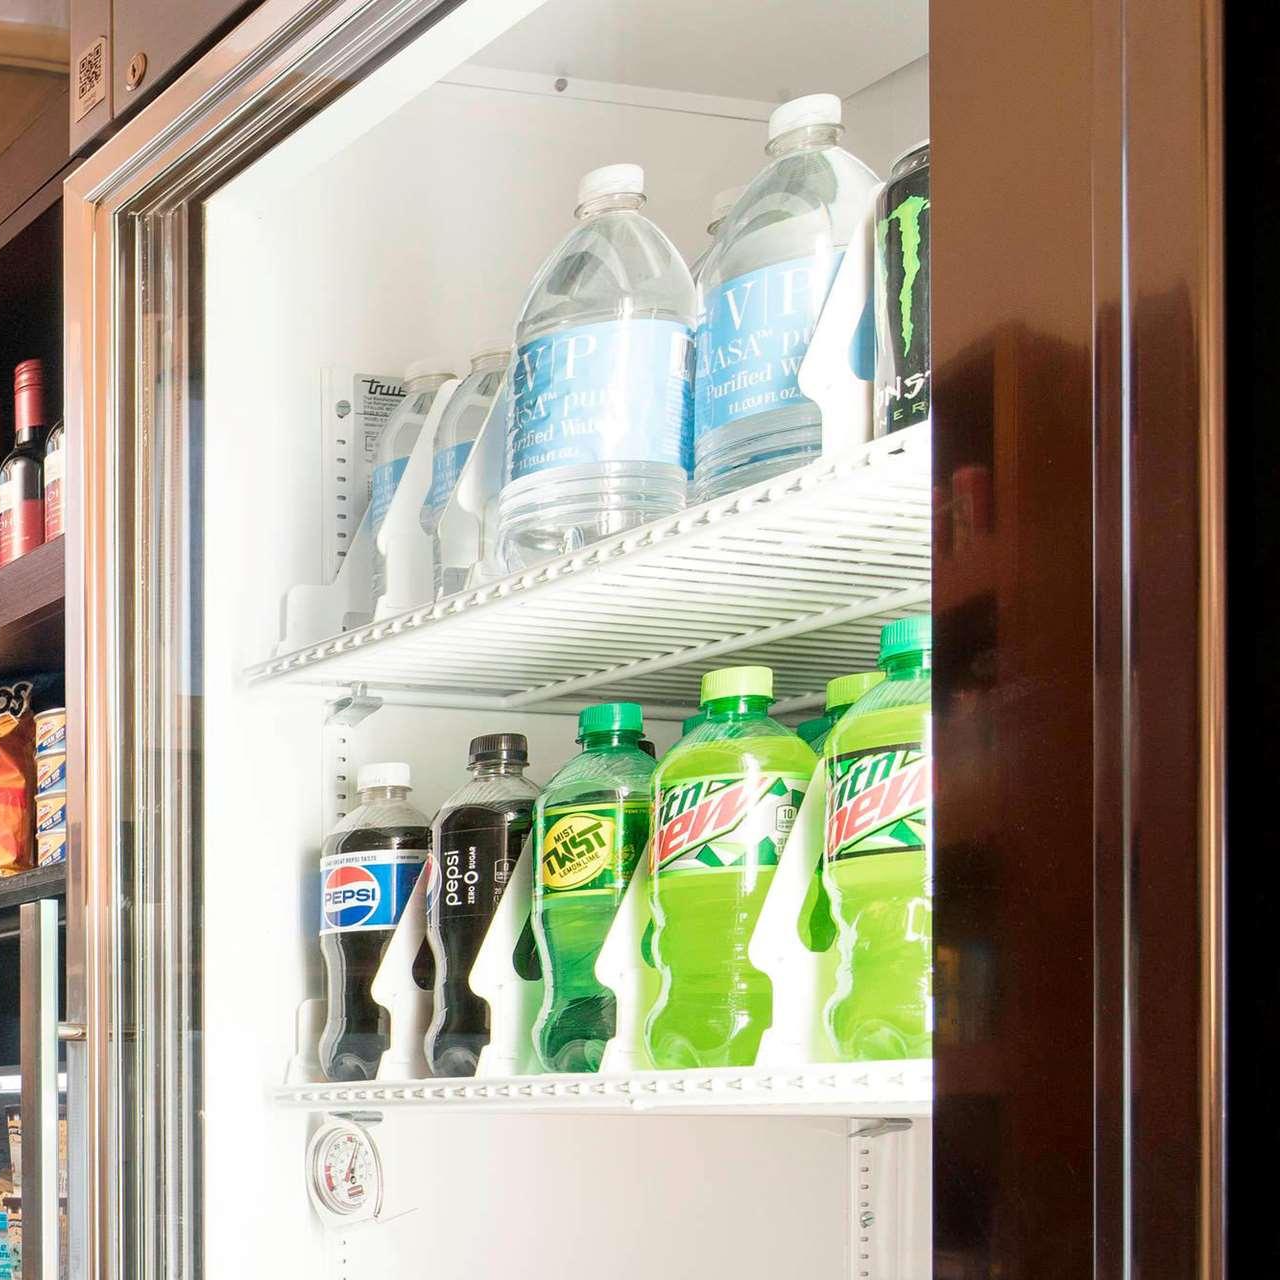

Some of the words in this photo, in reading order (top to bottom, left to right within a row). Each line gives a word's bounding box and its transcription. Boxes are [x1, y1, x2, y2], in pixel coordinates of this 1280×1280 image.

[707, 364, 772, 404] Purified
[782, 808, 794, 820] 10
[553, 825, 575, 845] MIST
[469, 846, 477, 870] SUGAR
[559, 858, 582, 878] LEMON
[444, 850, 463, 907] pepsi
[325, 887, 376, 905] PEPSI
[467, 886, 476, 905] ZERO
